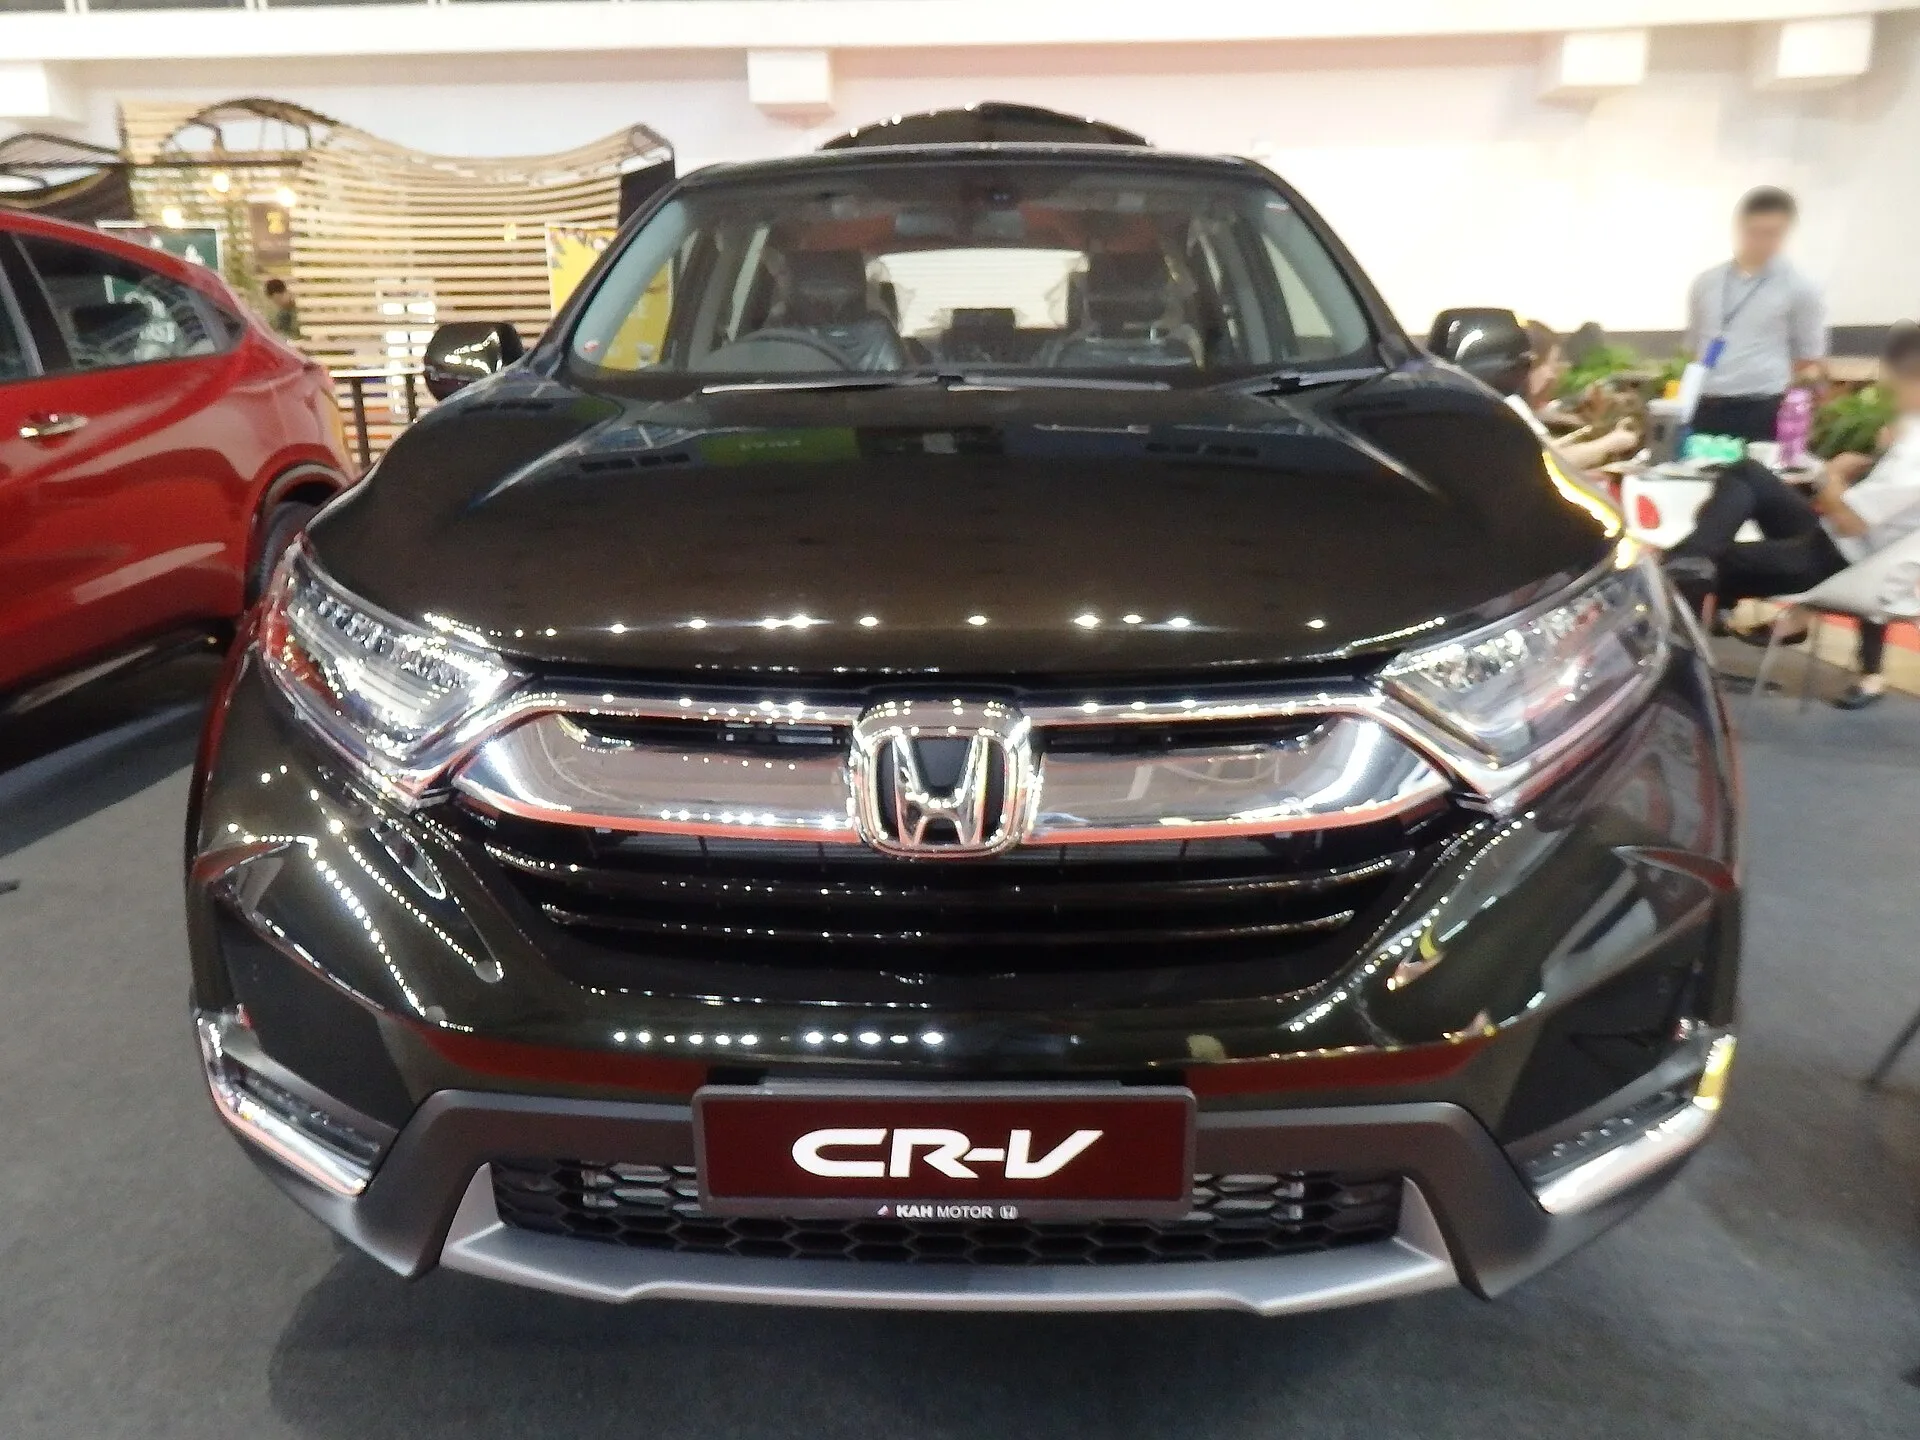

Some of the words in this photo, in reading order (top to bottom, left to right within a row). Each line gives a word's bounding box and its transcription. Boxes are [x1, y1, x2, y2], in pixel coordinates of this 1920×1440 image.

[791, 1127, 1104, 1179] CR-V
[896, 1205, 933, 1218] KAH
[937, 1205, 993, 1219] MOTOR
